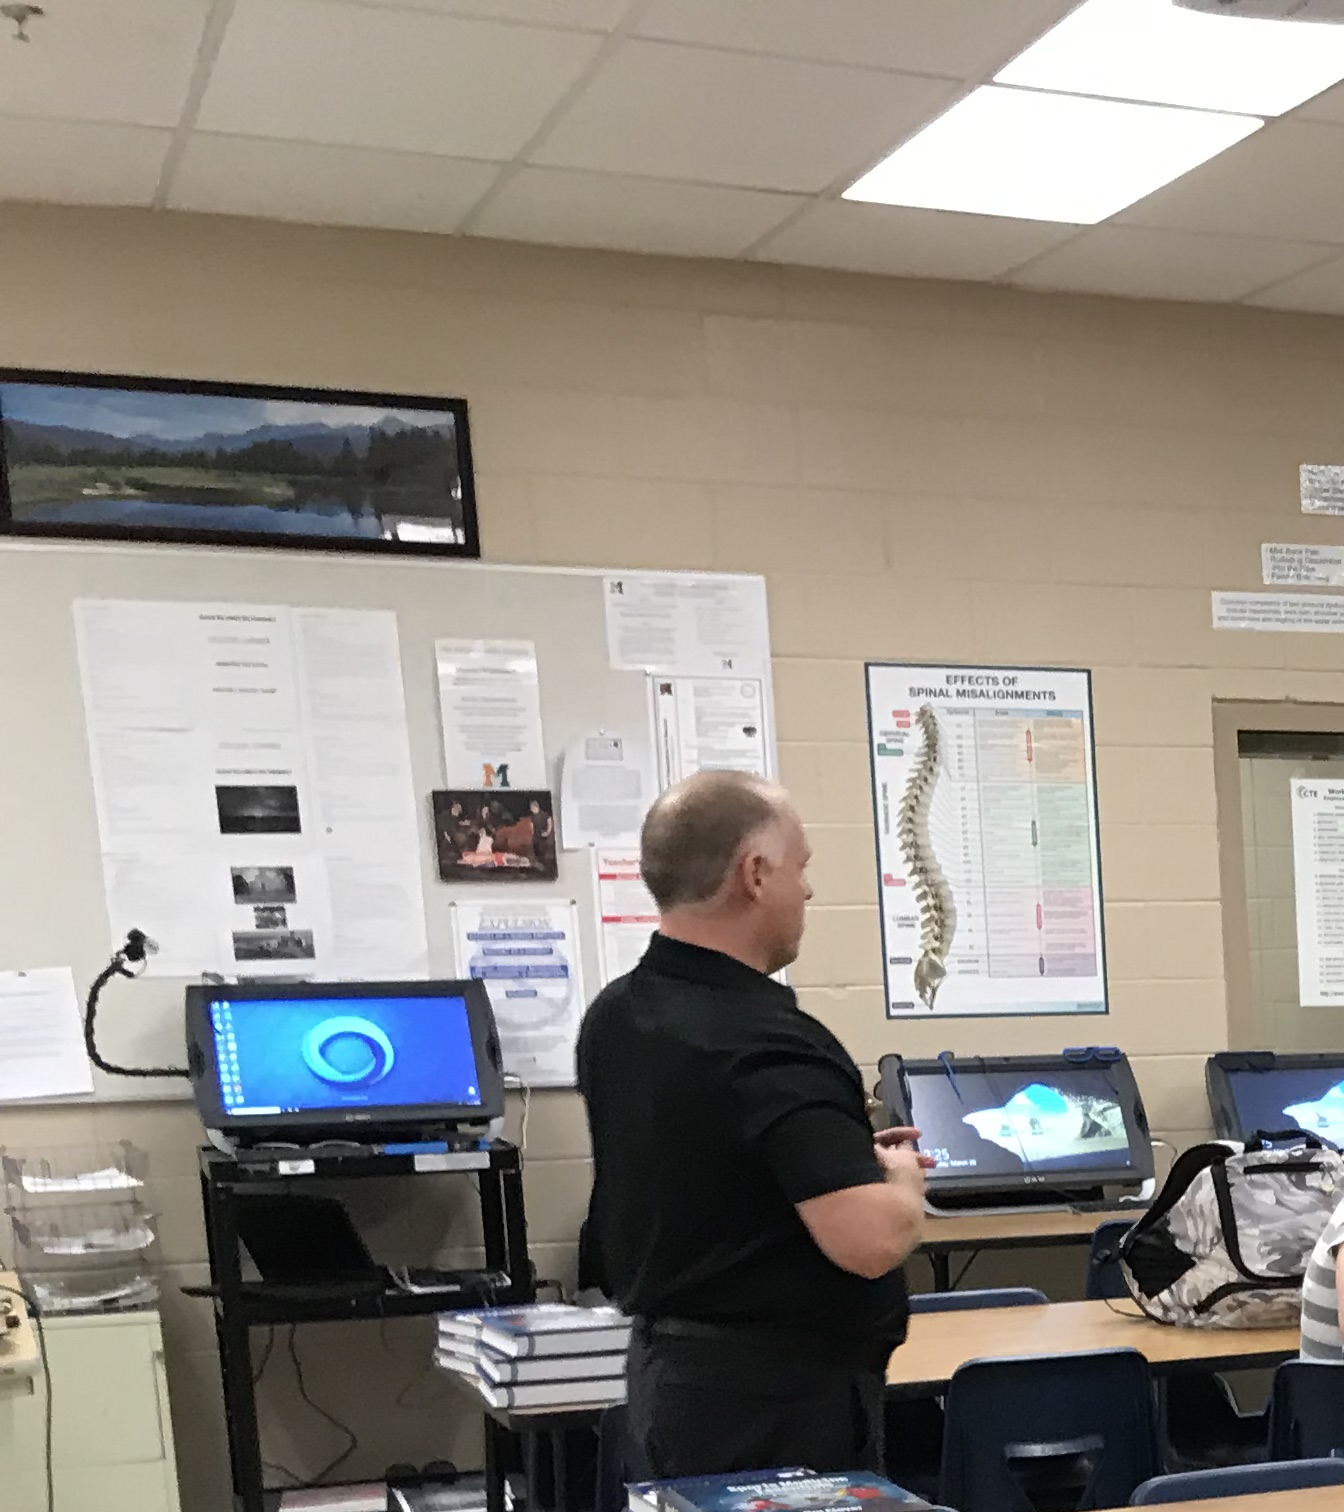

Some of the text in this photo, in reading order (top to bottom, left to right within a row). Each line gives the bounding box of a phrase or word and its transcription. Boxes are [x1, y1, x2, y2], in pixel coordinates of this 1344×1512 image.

[945, 674, 1019, 686] EFFECTS OF
[908, 686, 1057, 702] SPINAL MISALIGNMENTS
[482, 762, 511, 788] M
[1303, 789, 1318, 799] CTE
